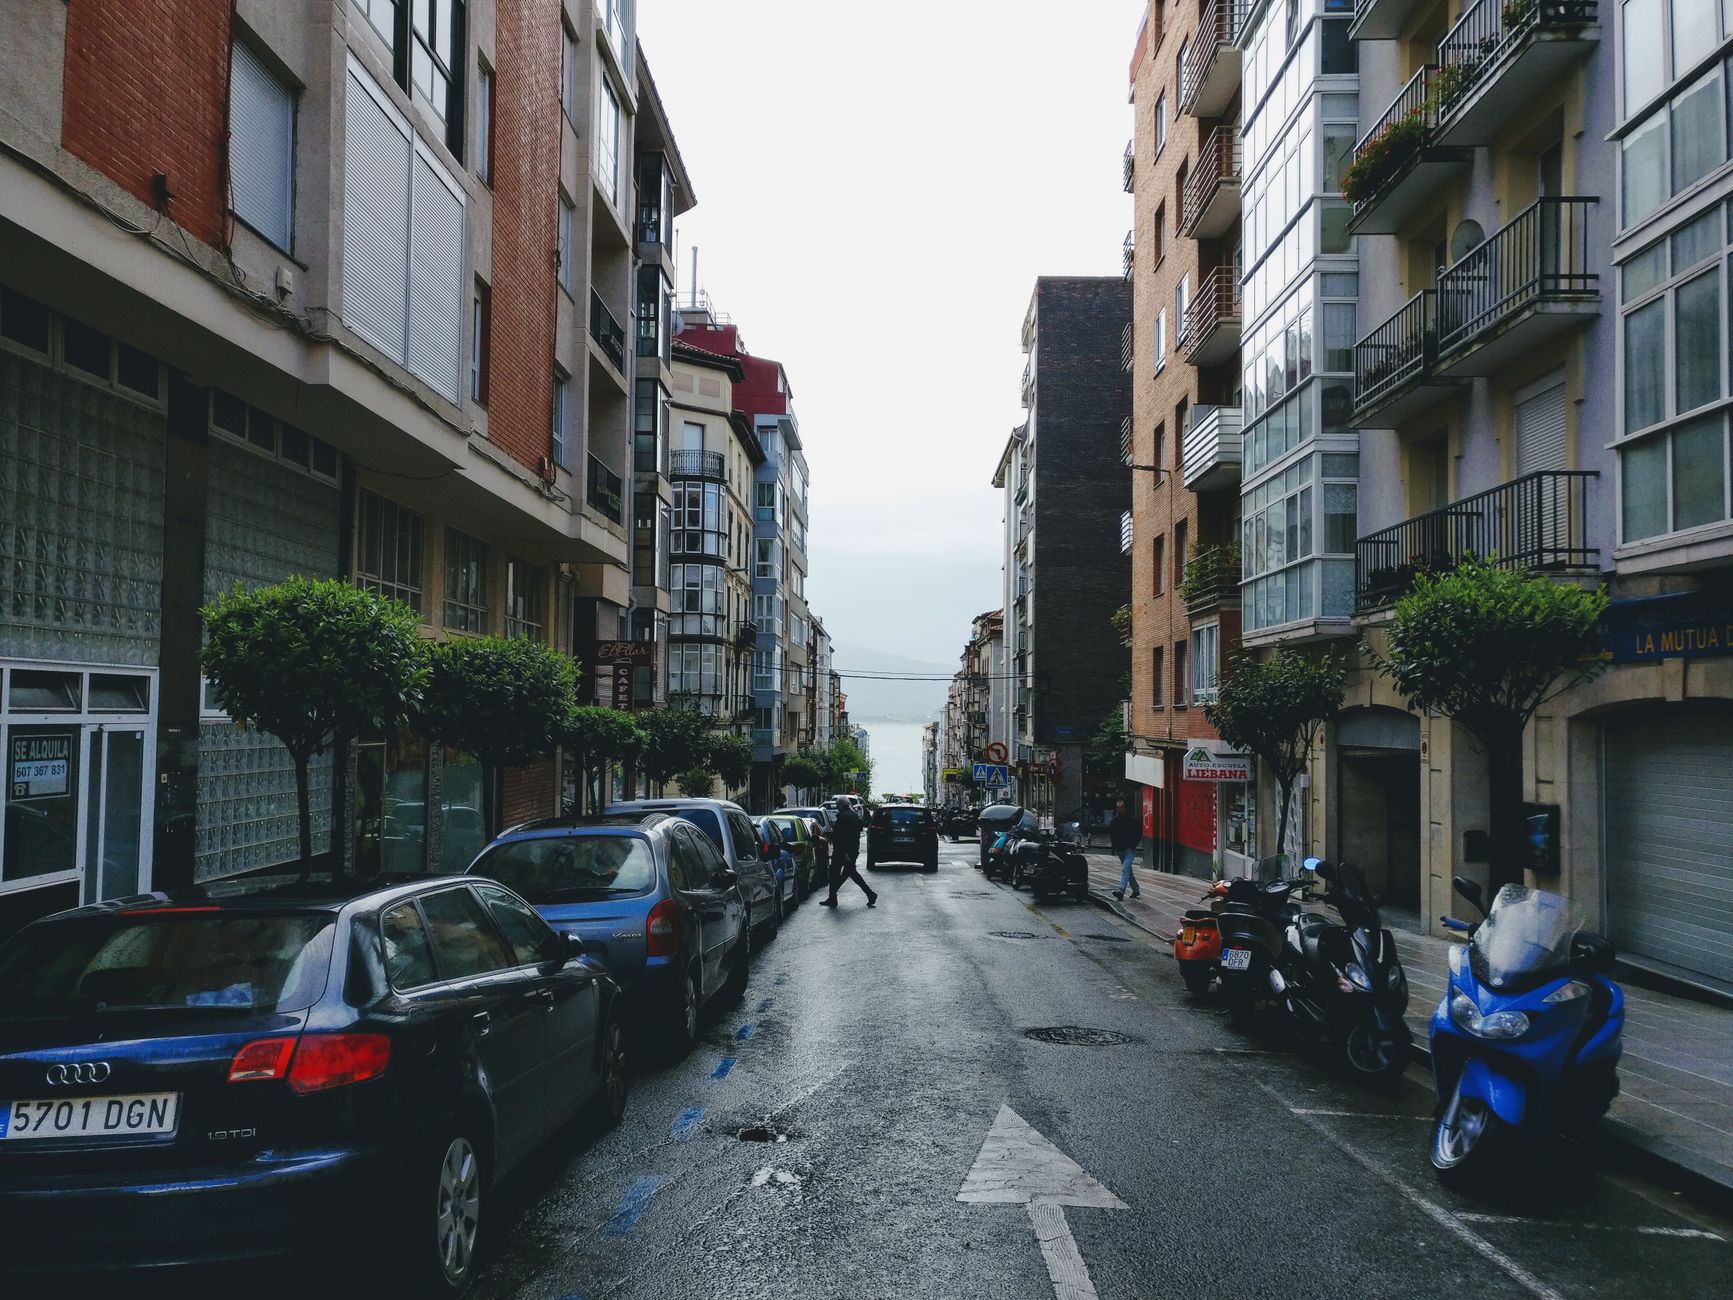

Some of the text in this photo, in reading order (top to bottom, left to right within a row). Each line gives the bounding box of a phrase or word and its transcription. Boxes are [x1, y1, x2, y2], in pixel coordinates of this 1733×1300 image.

[1635, 633, 1655, 655] LA
[1660, 626, 1719, 652] MUTUA
[14, 739, 69, 760] SE ALQUILA
[16, 764, 65, 778] 607 367 831
[1228, 958, 1244, 966] DFR
[1229, 950, 1249, 959] 6870
[14, 1098, 168, 1132] 5701 DGN
